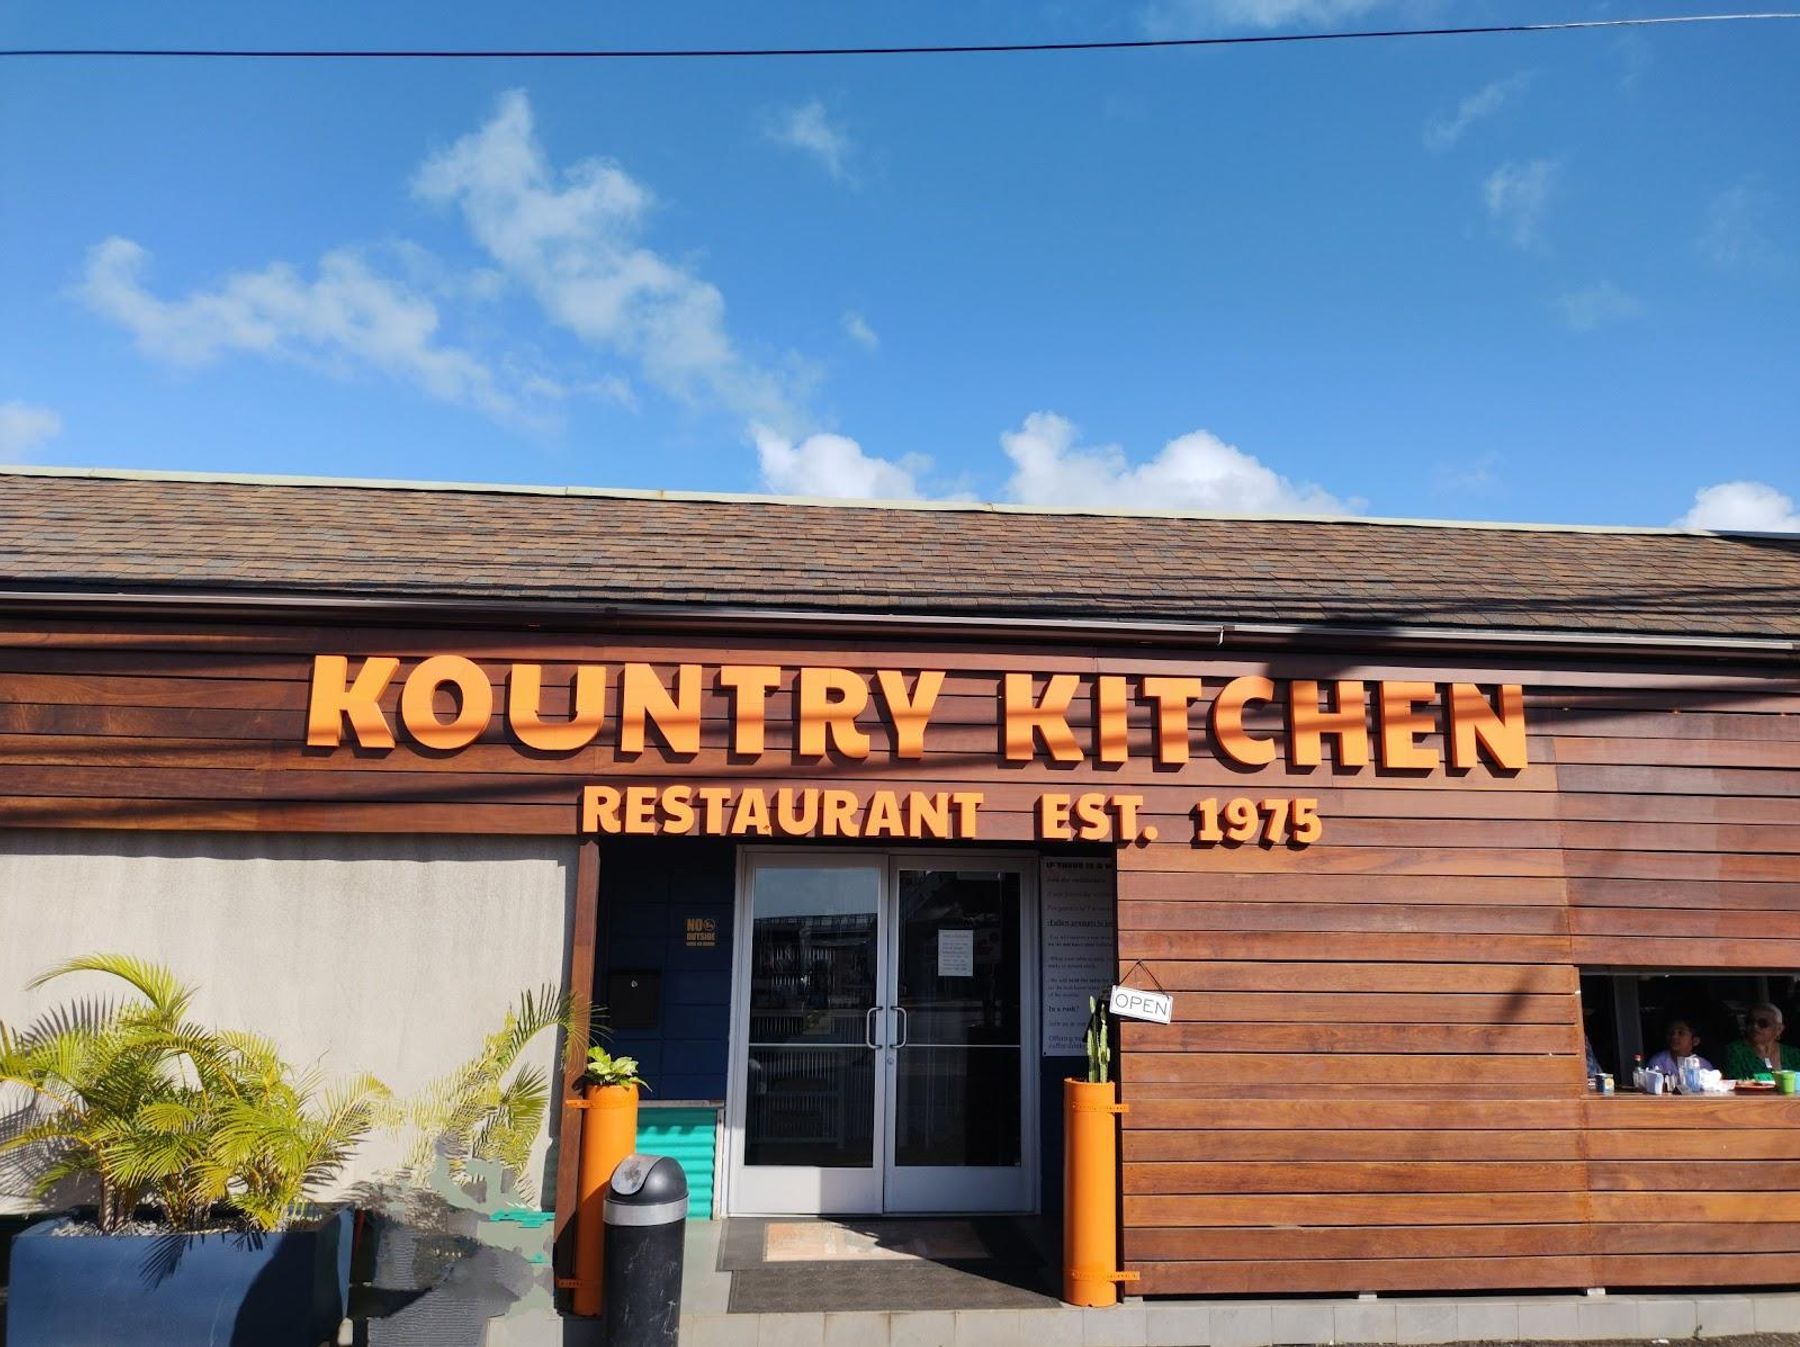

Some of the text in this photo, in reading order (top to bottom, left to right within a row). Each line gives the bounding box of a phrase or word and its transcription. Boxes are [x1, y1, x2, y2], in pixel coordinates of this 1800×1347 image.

[306, 654, 1529, 769] KOUNTRY KITCHEN
[582, 785, 1323, 844] RESTAURANT EST. 1975
[687, 918, 703, 931] NO
[1115, 993, 1168, 1016] OPEN
